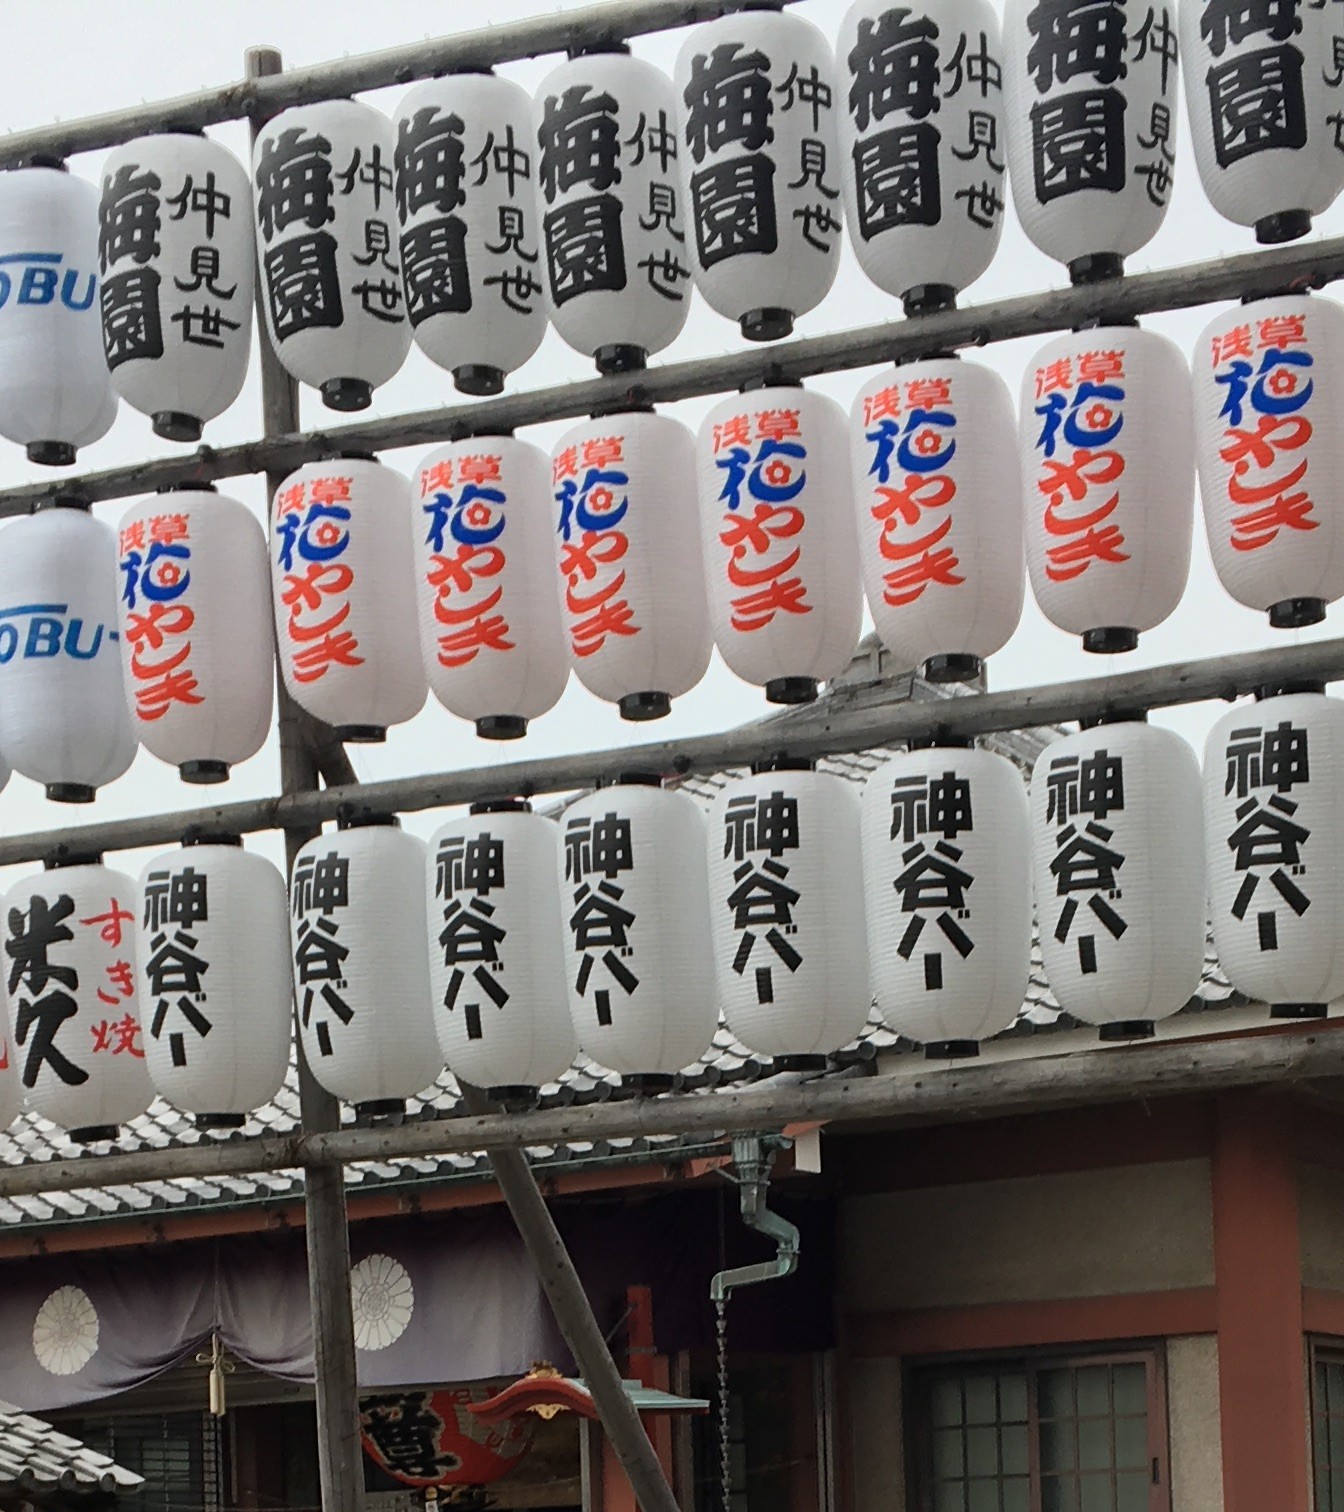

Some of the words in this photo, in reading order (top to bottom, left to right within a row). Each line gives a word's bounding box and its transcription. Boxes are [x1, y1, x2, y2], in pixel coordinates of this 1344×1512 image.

[538, 86, 626, 308] 梅園
[684, 44, 777, 268] 梅園
[775, 62, 841, 254] 仲見世
[848, 9, 943, 242] 梅園
[943, 32, 1005, 230] 仲見世
[1128, 7, 1177, 207] 仲見世
[99, 166, 163, 368] 梅園
[166, 172, 241, 350] 仲見世
[256, 127, 343, 340] 梅園
[335, 144, 404, 323] 仲見世
[394, 108, 472, 329] 梅園
[470, 123, 541, 315] 仲見世
[624, 110, 689, 301] 仲見世
[714, 410, 799, 452] 浅草
[864, 379, 950, 425] 浅草
[1036, 352, 1123, 397] 浅草
[1212, 316, 1306, 367] 浅草
[121, 515, 188, 552] 浅草
[279, 478, 351, 514] 浅草
[422, 456, 500, 494] 浅草
[554, 438, 626, 486] 浅草
[714, 442, 811, 632] 花やしき
[864, 409, 964, 607] 花やしき
[1036, 384, 1132, 583] 花やしき
[1212, 350, 1318, 552] 花やしき
[120, 543, 204, 722] 花やしき
[278, 505, 363, 685] 花やしき
[422, 482, 514, 668] 花やしき
[554, 470, 639, 658] 花やしき
[565, 812, 639, 1026] 神谷バー
[724, 790, 803, 1004] 神谷バー
[891, 771, 974, 991] 神谷バー
[1046, 750, 1128, 975] 神谷バー
[1225, 721, 1311, 951] 神谷バー
[6, 895, 88, 1088] 米久
[80, 900, 144, 1058] すき焼
[143, 868, 212, 1067] 神谷バー
[294, 849, 354, 1057] 神谷バー
[436, 833, 510, 1040] 神谷バー
